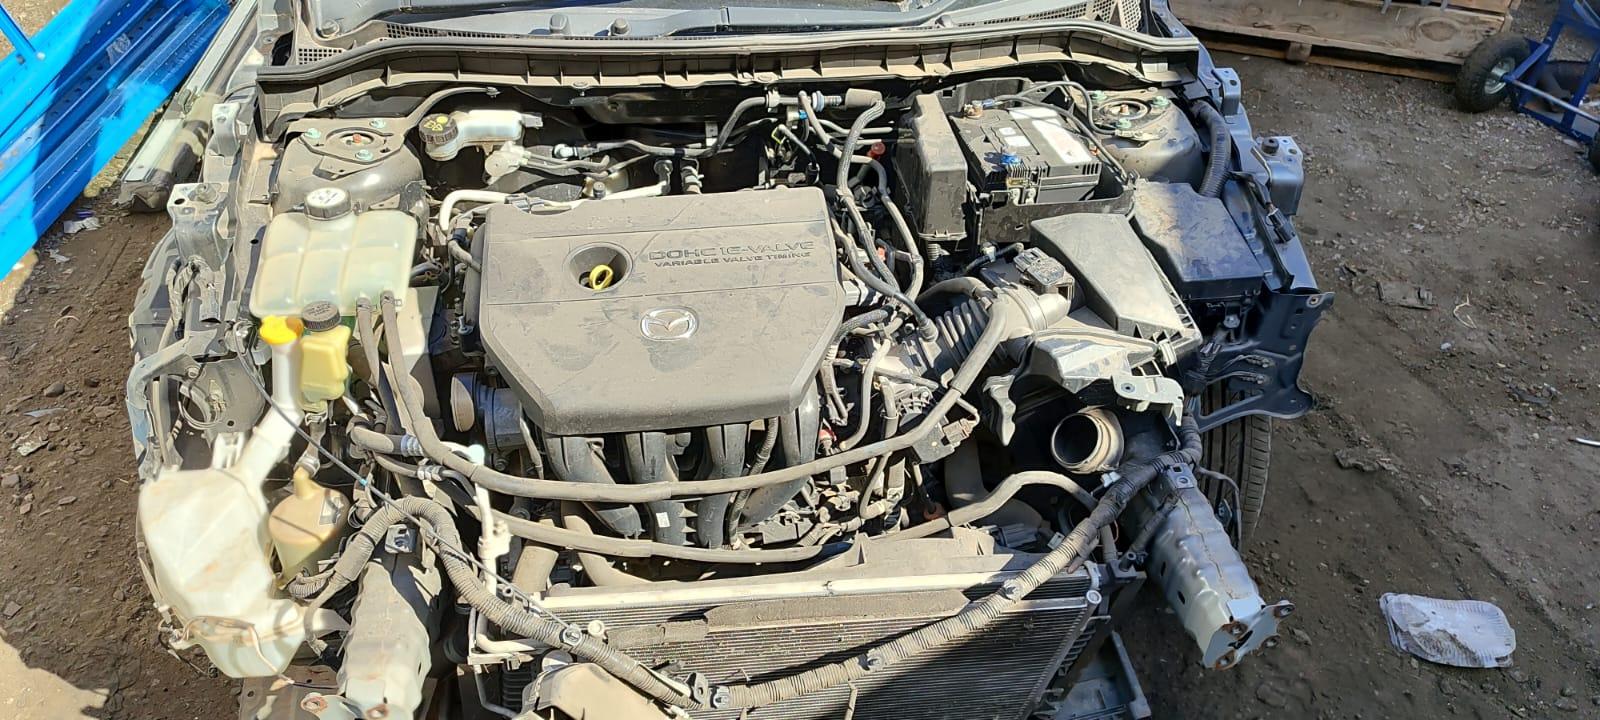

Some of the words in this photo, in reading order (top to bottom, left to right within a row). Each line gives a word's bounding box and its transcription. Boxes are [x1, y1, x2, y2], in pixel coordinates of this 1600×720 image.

[649, 247, 717, 260] DOHC
[720, 241, 815, 256] 16-VALVE
[654, 258, 719, 267] VARIABLE
[723, 255, 763, 263] VALVE
[766, 252, 811, 260] TIMING
